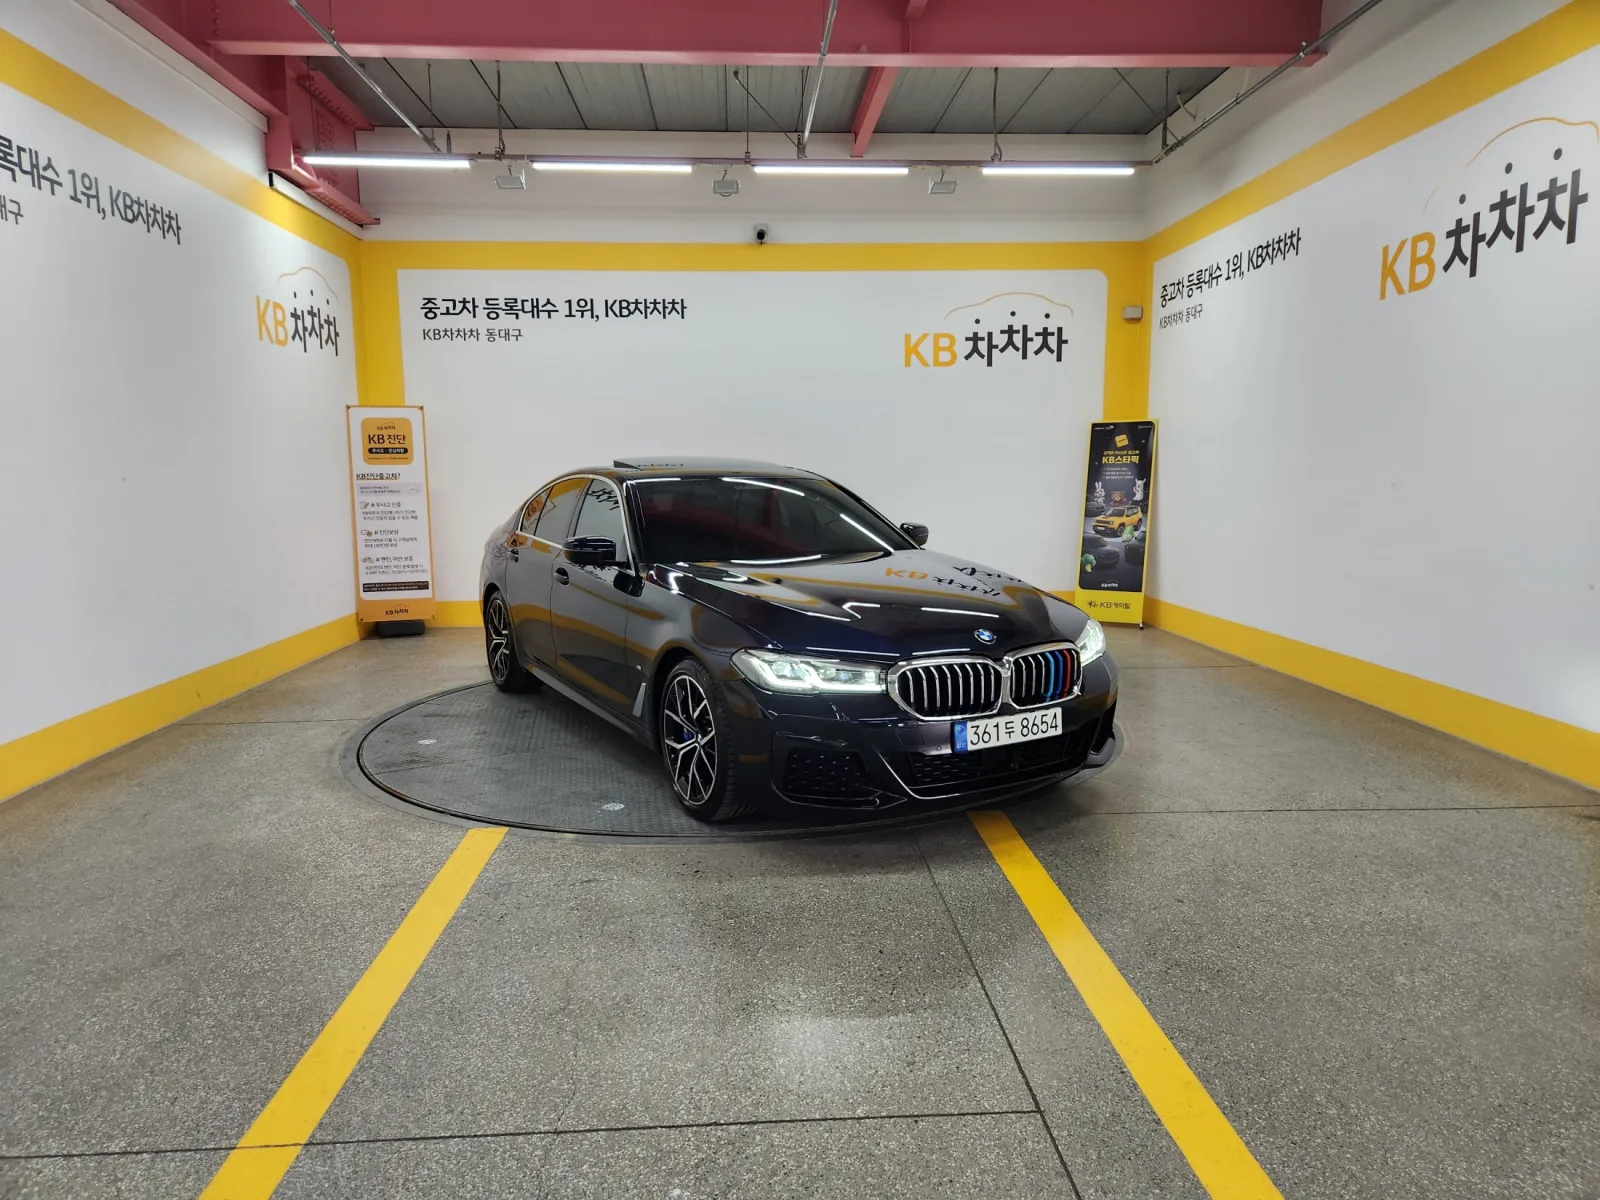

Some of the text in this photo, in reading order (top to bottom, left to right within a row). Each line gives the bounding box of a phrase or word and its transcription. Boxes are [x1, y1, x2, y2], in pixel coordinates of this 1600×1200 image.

[68, 169, 106, 220] 1위,
[109, 184, 182, 246] KB차차차
[1160, 227, 1302, 308] 중고차 등록대수 1위, KB차차차
[420, 297, 687, 322] 중고차 등록대수 1위, KB차차차
[1159, 303, 1203, 330] KB차차차 동대구
[422, 328, 524, 343] KB차차차 동대구
[970, 712, 1059, 746] 361두 8654
